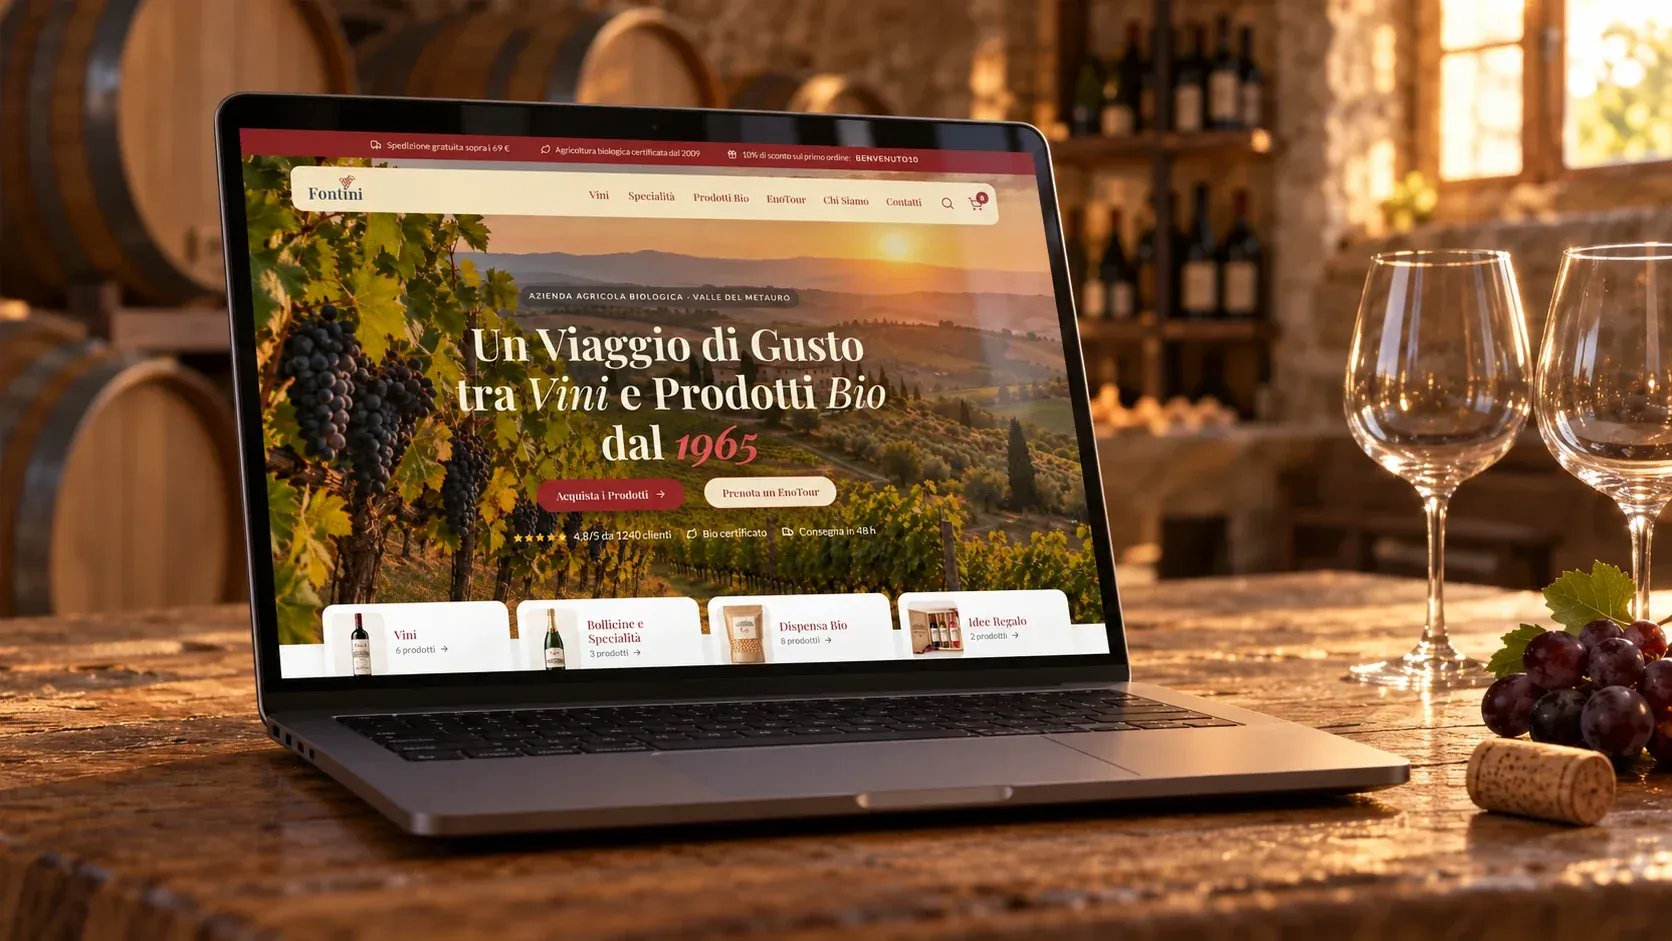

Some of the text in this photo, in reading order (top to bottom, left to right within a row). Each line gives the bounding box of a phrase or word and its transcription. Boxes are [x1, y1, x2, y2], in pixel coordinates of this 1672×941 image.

[432, 143, 464, 152] gratuita
[465, 145, 487, 153] sopra
[492, 144, 503, 152] 69
[555, 146, 701, 158] Agricoltura biologica certificata dal 2009
[743, 151, 759, 159] 10%
[767, 152, 792, 160] sconto
[793, 152, 803, 160] sul
[804, 153, 825, 162] primo
[826, 153, 851, 162] ordine:
[308, 187, 363, 200] Fontini
[589, 190, 609, 200] Vini
[628, 191, 675, 202] Specialità
[693, 192, 750, 203] Prodotti Bio
[766, 194, 807, 204] EnoTour
[823, 195, 869, 206] Chi Siamo
[886, 197, 922, 207] Contatti
[528, 292, 573, 300] AZIENDA
[576, 292, 627, 301] AGRICOLA
[629, 293, 683, 301] BIOLOGICA
[692, 293, 722, 301] VALLE
[724, 293, 742, 301] DEL
[745, 294, 791, 302] METAURO
[471, 325, 864, 370] Un Viaggio di Gusto
[455, 374, 886, 412] tra Vini e Prodotti Bio
[601, 424, 759, 468] dal 1965
[556, 490, 600, 503] Acquista
[608, 489, 649, 500] Prodotti
[722, 489, 761, 498] Prenota
[778, 488, 820, 497] EnoTour
[601, 531, 614, 540] da
[616, 531, 641, 540] 1240
[642, 530, 672, 540] clienti
[702, 528, 767, 538] Bio certificato
[799, 527, 844, 538] Consegna
[856, 527, 869, 536] 48
[587, 619, 635, 630] Bollicine
[779, 620, 848, 633] Dispensa Bio
[968, 616, 1027, 629] Idee Regalo
[394, 629, 417, 640] Vini
[588, 632, 641, 646] Specialità
[402, 645, 436, 655] prodotti
[596, 649, 629, 658] prodotti
